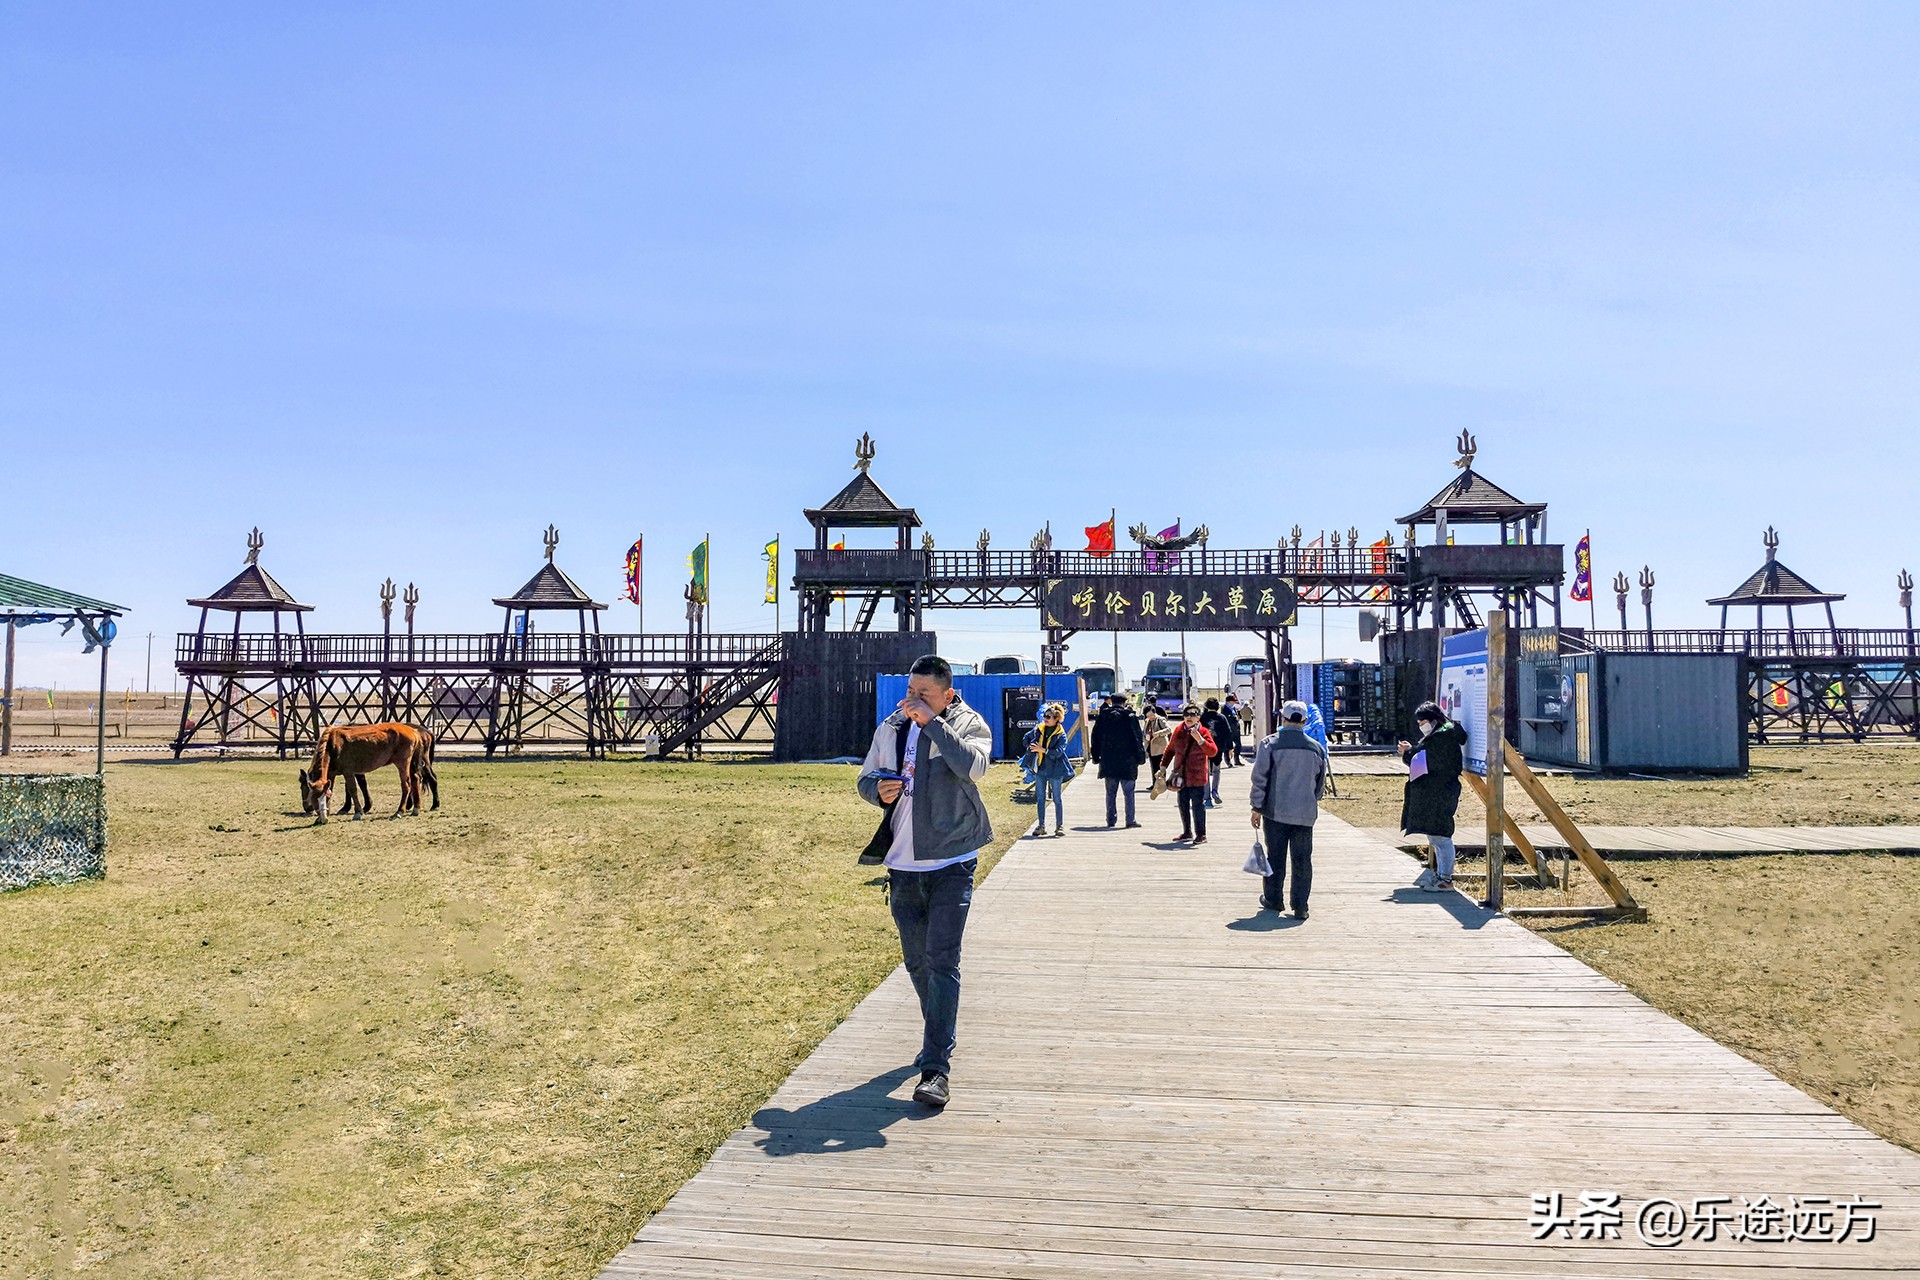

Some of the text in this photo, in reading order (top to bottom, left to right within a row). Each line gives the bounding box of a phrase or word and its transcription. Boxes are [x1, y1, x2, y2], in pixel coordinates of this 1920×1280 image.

[1072, 586, 1278, 618] 呼伦贝尔大草原
